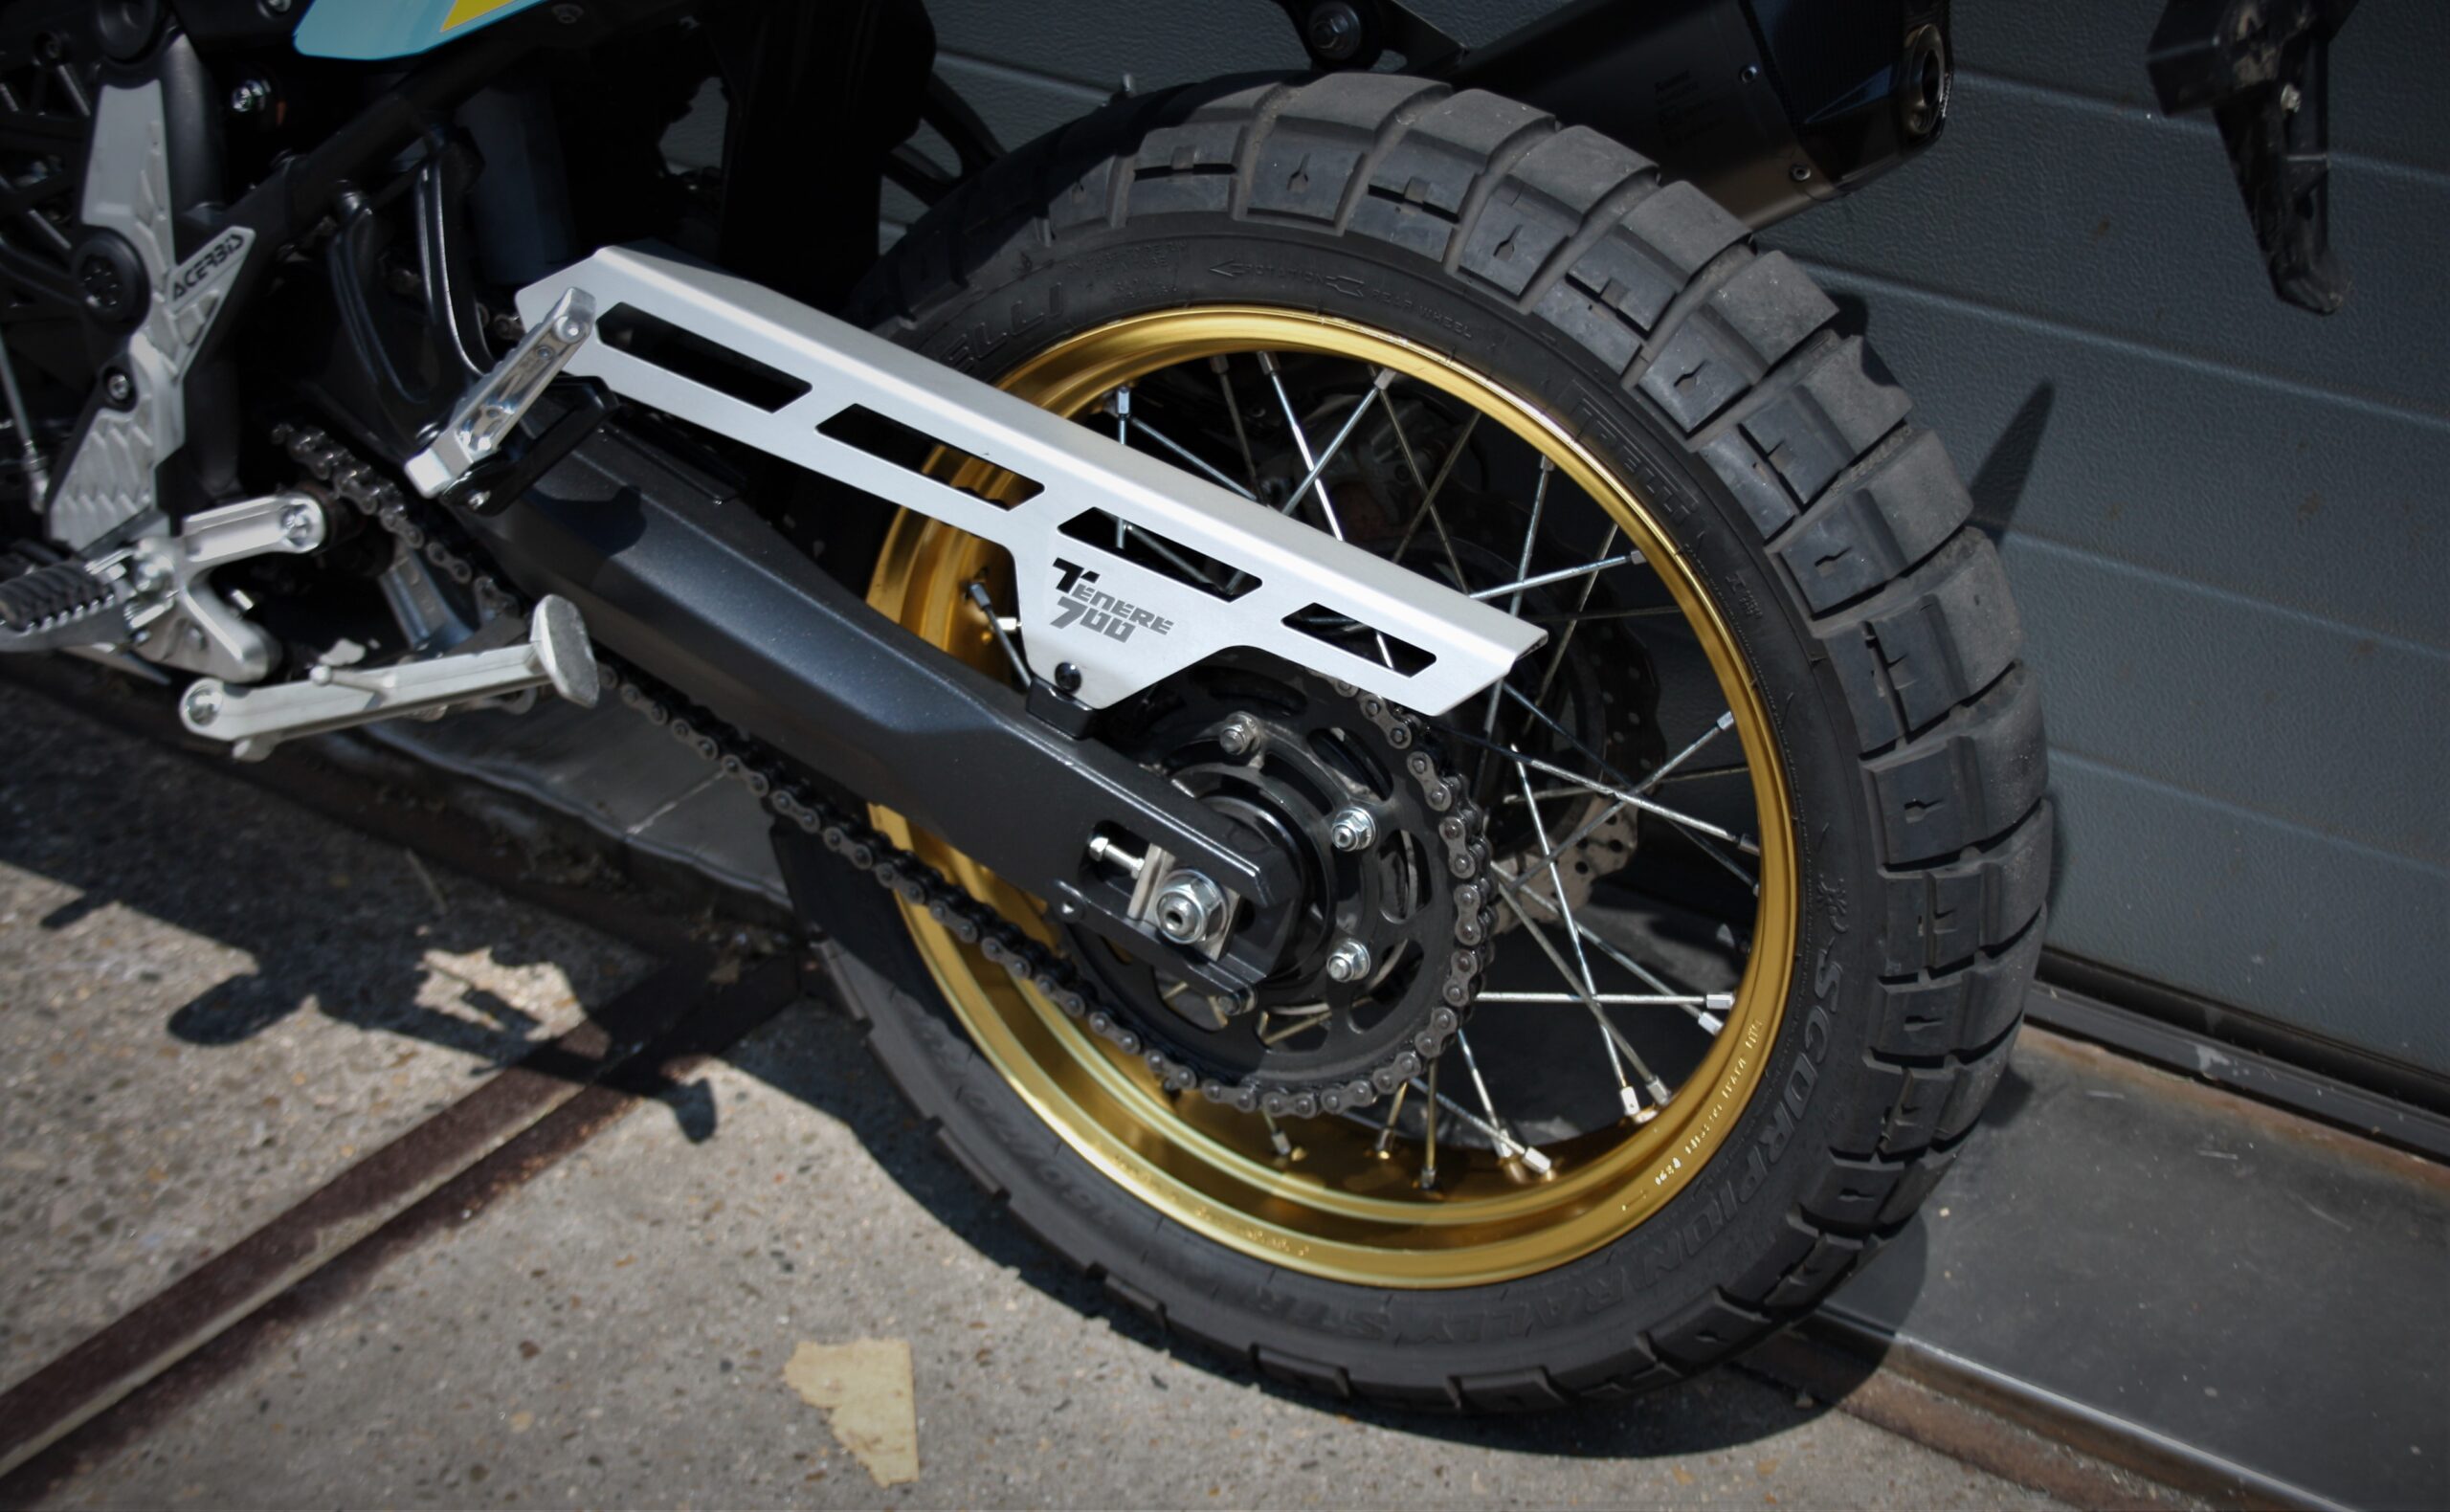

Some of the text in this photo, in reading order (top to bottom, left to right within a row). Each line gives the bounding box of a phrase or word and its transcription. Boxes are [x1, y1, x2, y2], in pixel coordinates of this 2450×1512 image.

[171, 233, 244, 301] ACERBIS
[1049, 595, 1137, 644] 700
[1641, 939, 1845, 1288] SCORPION
